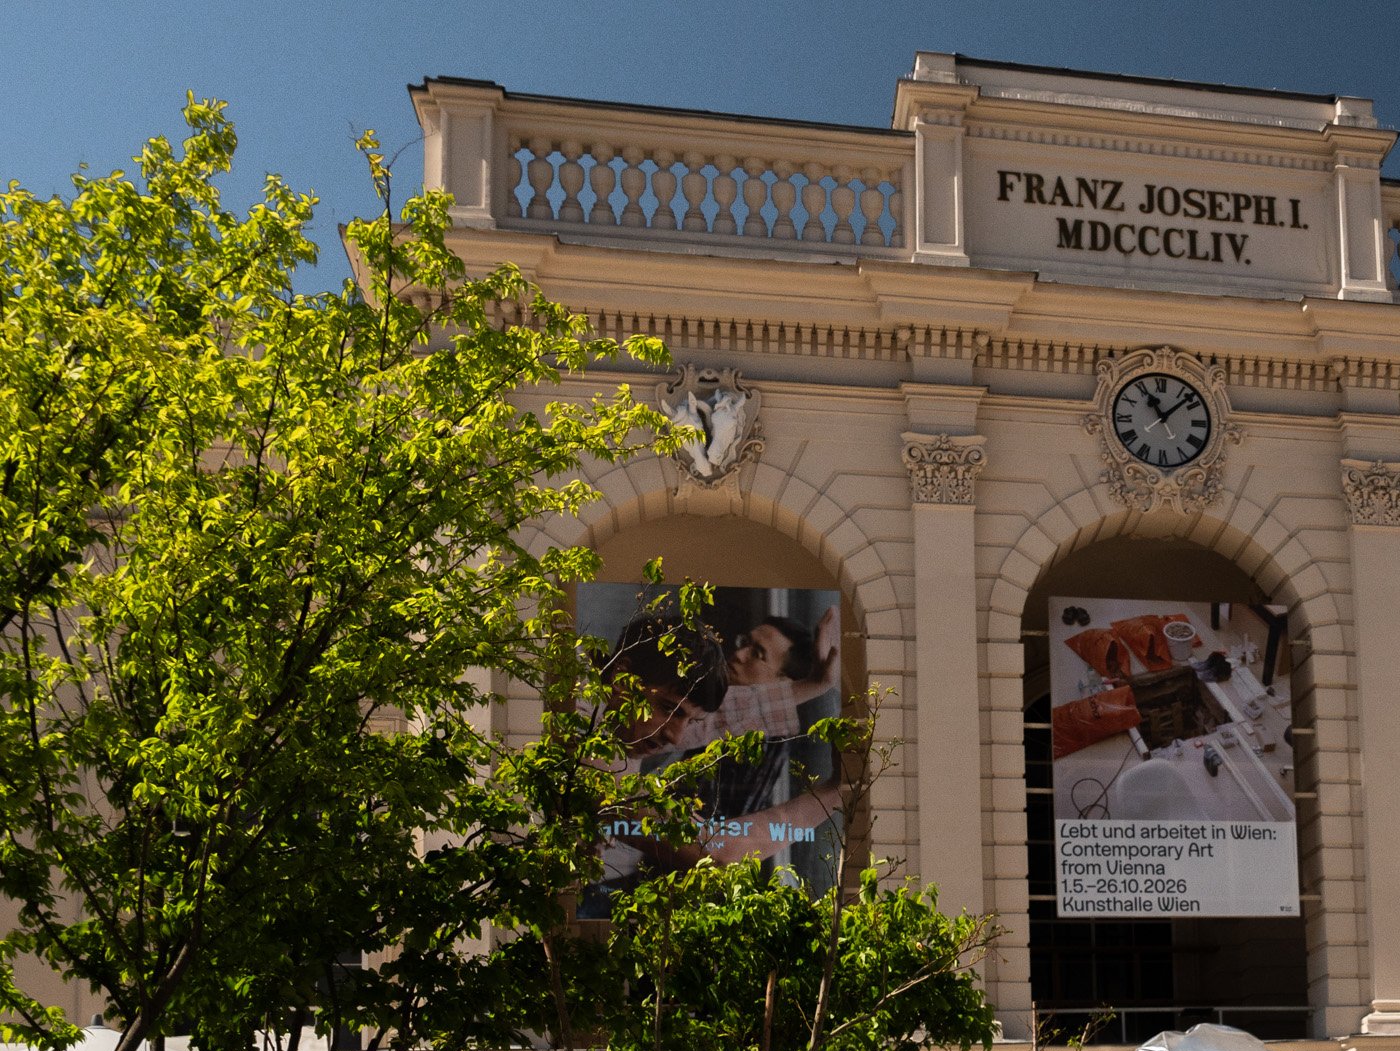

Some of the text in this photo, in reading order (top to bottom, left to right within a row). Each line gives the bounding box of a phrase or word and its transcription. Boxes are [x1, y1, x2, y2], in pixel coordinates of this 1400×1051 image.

[997, 170, 1125, 212] FRANZ
[1056, 218, 1252, 265] MDCCCLIV.
[769, 822, 816, 842] Wien
[1060, 823, 1277, 840] Lebt und arbeitet in Wien:
[1061, 841, 1214, 861] Contemporary Art
[1061, 860, 1166, 875] from Vienna
[1063, 897, 1200, 912] Kunsthalle Wien
